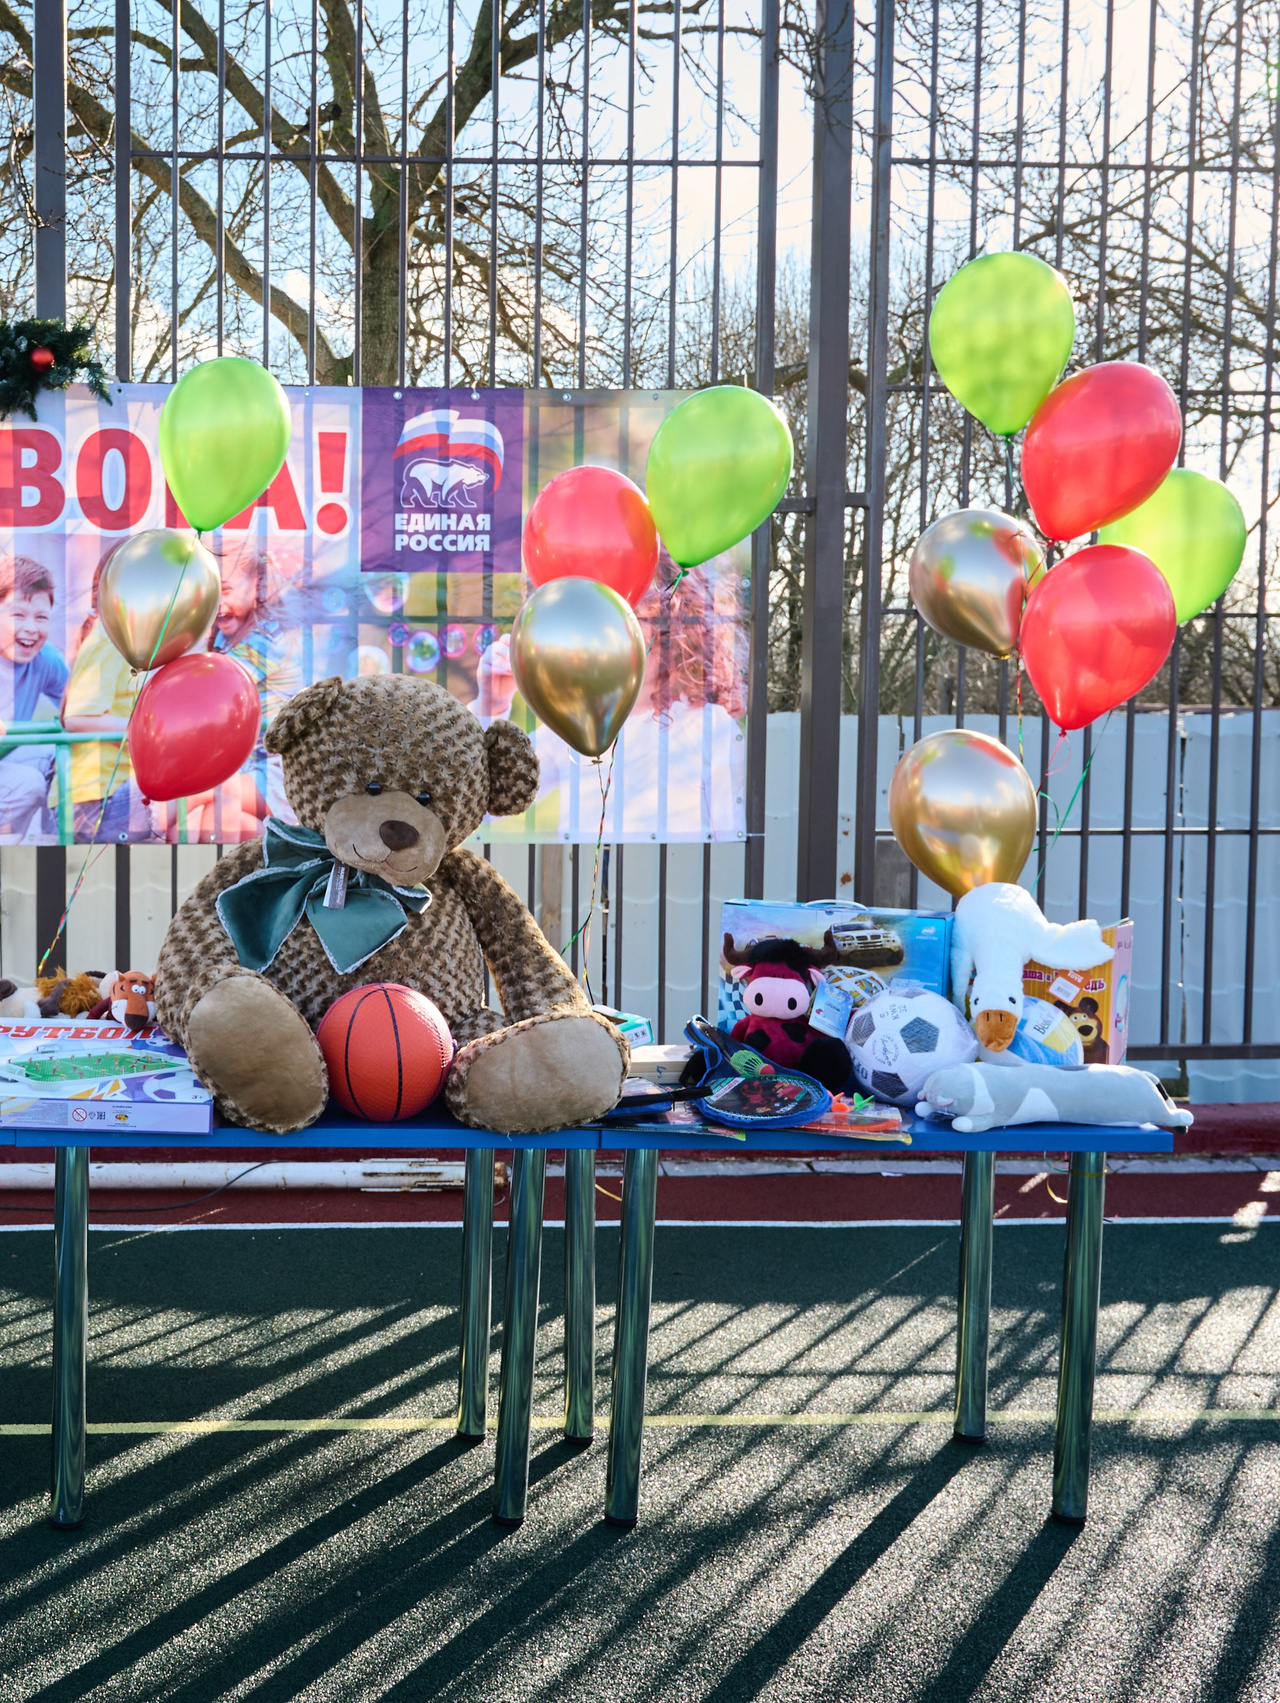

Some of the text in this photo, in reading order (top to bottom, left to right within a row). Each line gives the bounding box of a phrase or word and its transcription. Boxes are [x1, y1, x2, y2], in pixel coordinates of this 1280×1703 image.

[394, 513, 491, 533] ЕДИНАЯ
[394, 534, 491, 552] РОССИЯ
[1023, 969, 1043, 980] аша
